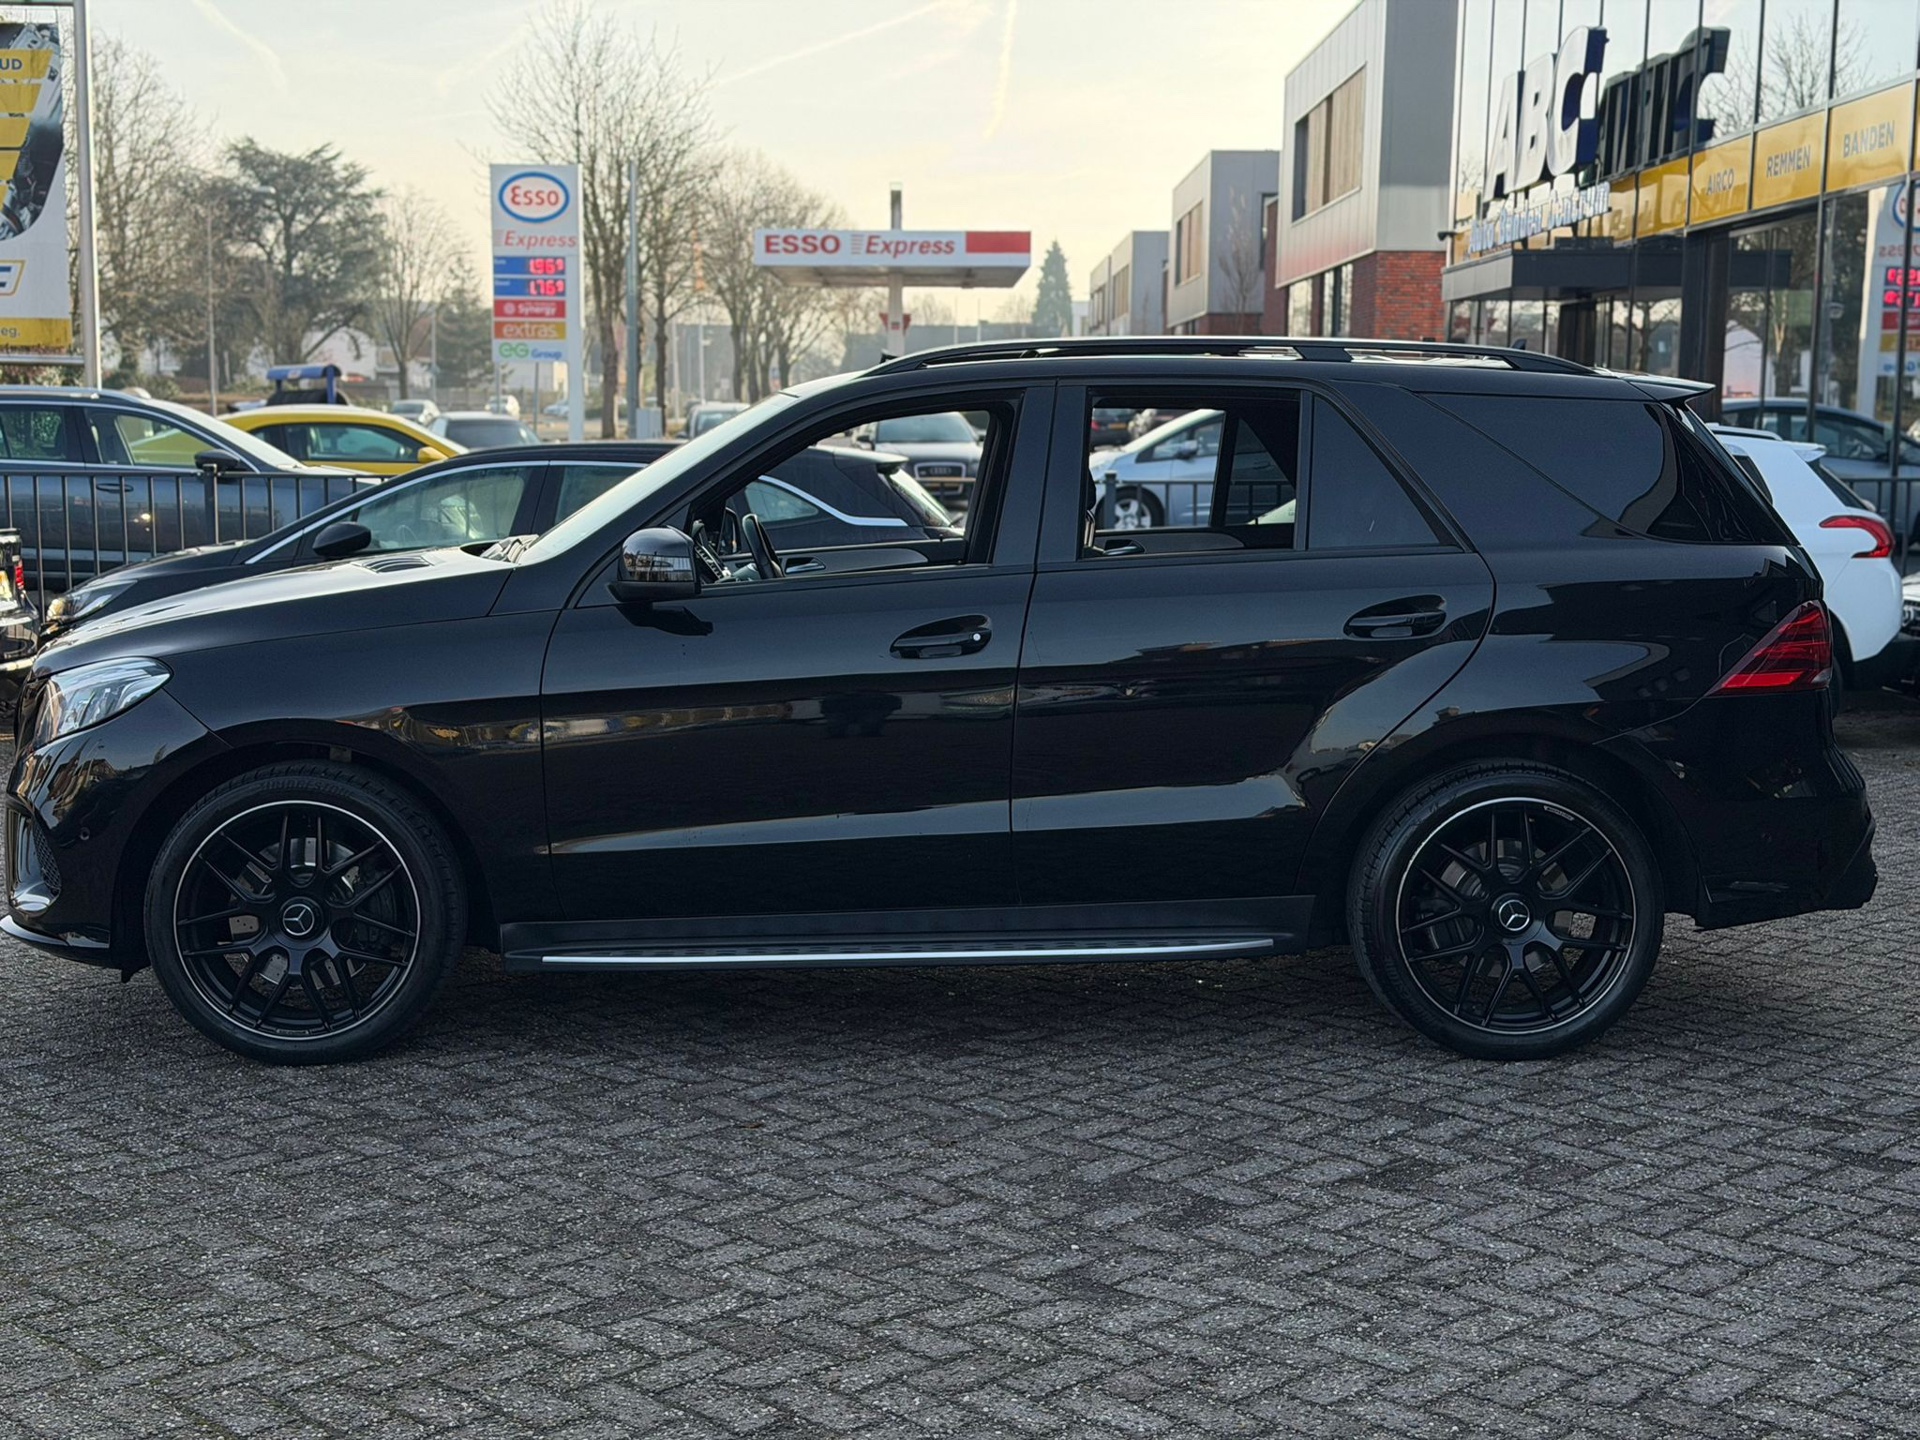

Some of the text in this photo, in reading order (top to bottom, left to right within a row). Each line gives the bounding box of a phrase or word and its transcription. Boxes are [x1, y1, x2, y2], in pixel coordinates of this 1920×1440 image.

[1481, 25, 1608, 204] ABC
[1843, 120, 1896, 159] BANDEN
[1765, 145, 1811, 178] REMMEN
[1706, 168, 1735, 196] AIRCO
[504, 230, 577, 250] Express
[764, 235, 955, 259] ESSO Express
[531, 348, 563, 360] Group
